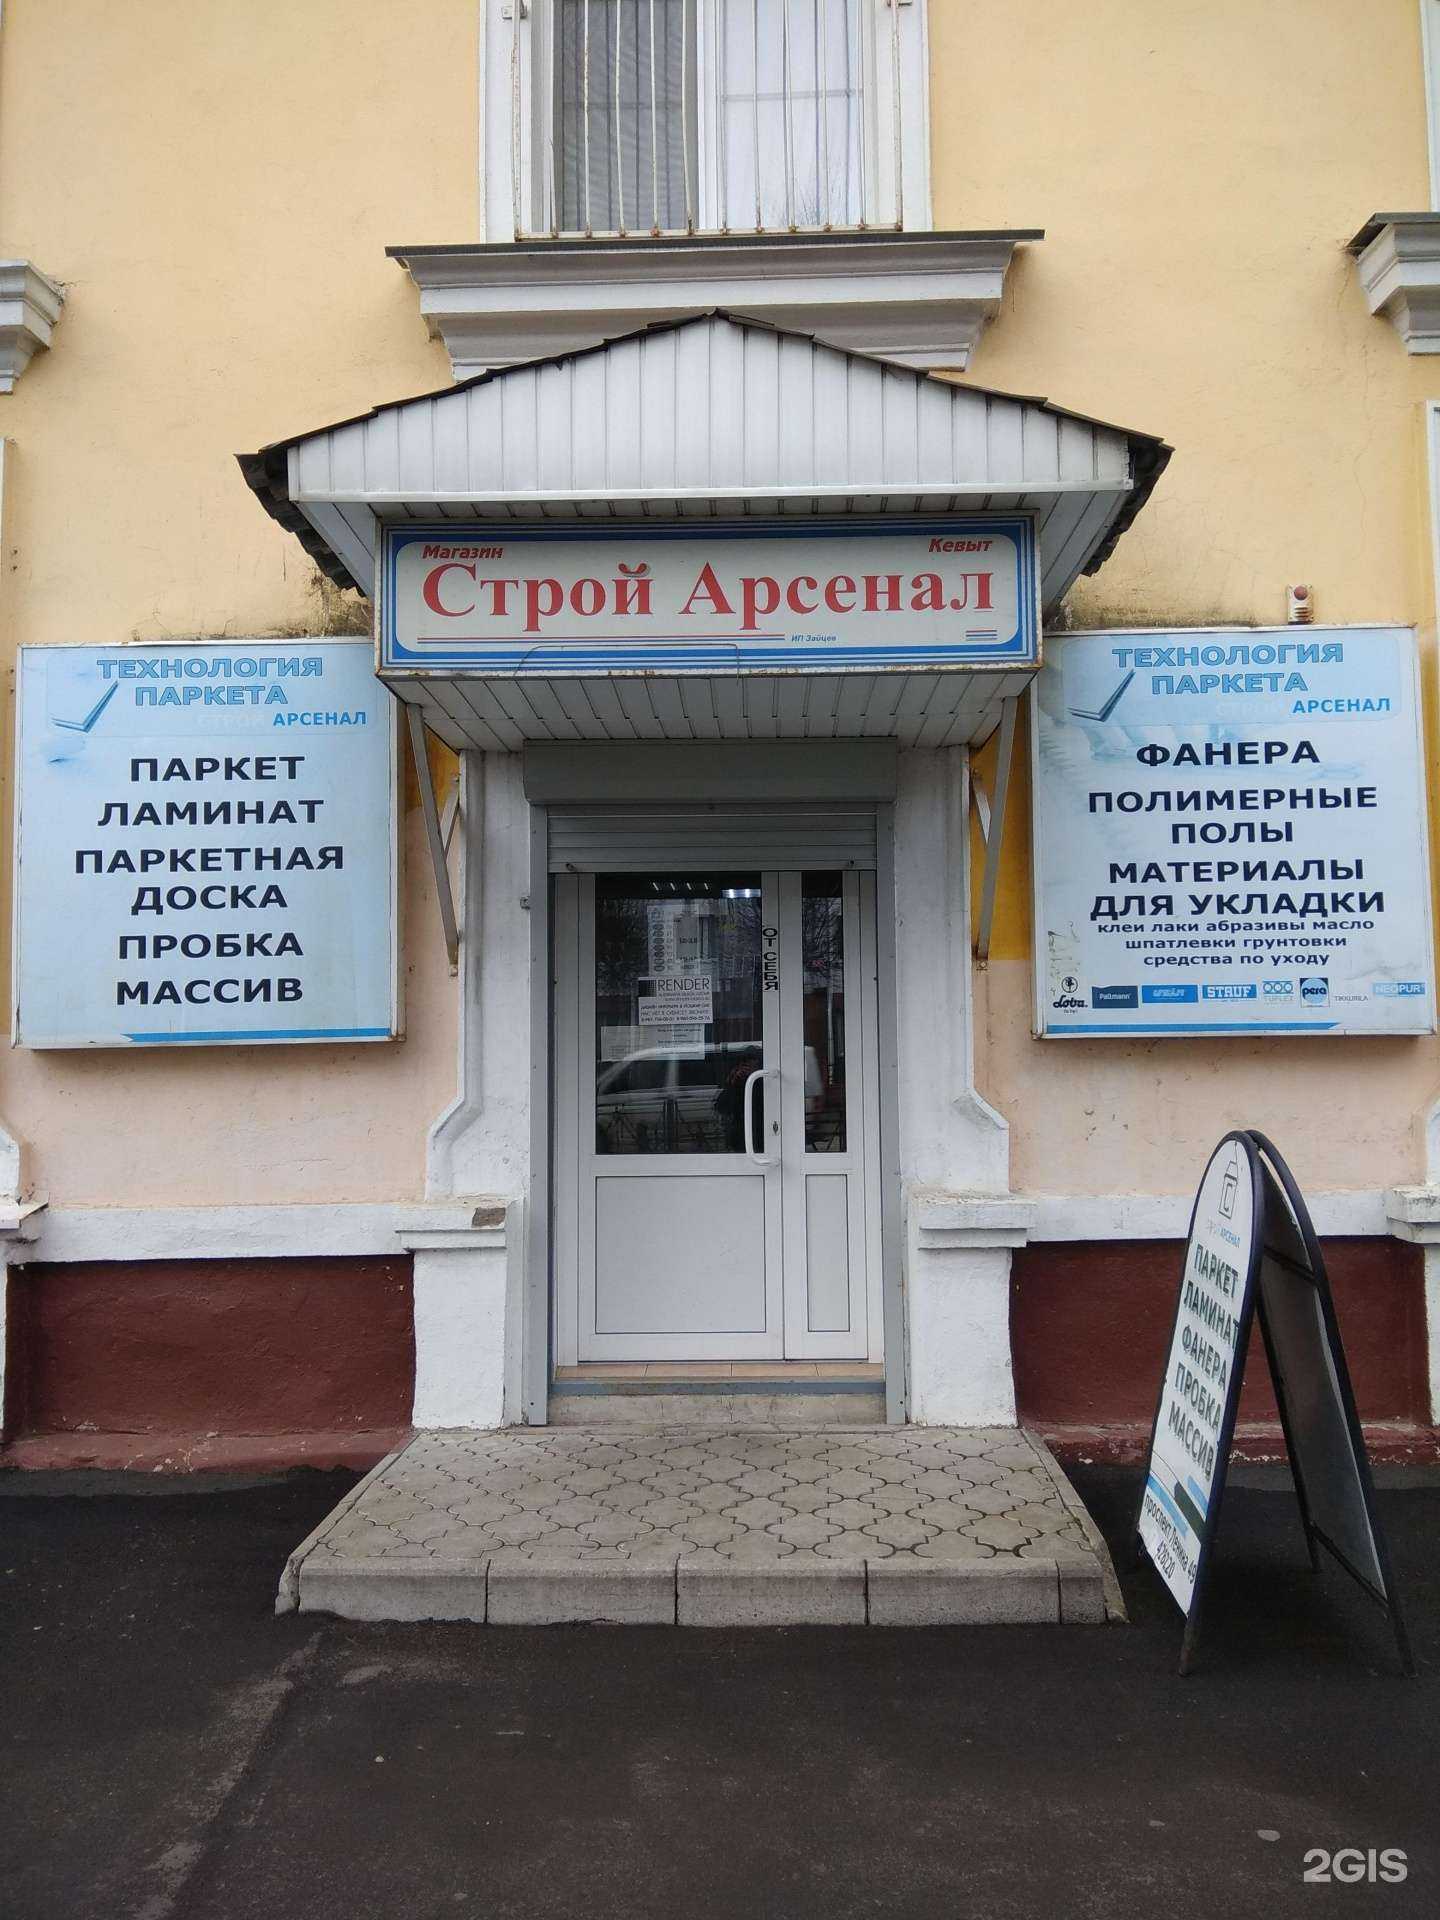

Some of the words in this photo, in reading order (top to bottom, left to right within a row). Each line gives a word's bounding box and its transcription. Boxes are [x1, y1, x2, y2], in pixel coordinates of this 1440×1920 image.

[422, 545, 503, 559] Магазин
[929, 537, 993, 553] Кевыт
[422, 562, 654, 632] Строй
[678, 561, 995, 630] Арсенал
[97, 657, 323, 679] ТЕХНОЛОГИЯ
[1112, 643, 1344, 668] ТЕХНОЛОГИЯ
[135, 685, 288, 706] ПАРКЕТА
[1152, 672, 1308, 695] ПАРКЕТА
[1292, 698, 1391, 714] АРСЕНАЛ
[273, 711, 367, 727] АРСЕНАЛ
[1136, 740, 1320, 767] ФАНЕРА
[131, 756, 305, 782] ПАРКЕТ
[1089, 786, 1378, 813] ПОЛИМЕРНЫЕ
[98, 800, 324, 826] ЛАМИНАТ
[1172, 821, 1293, 845] ПОЛЫ
[75, 846, 344, 873] ПАРКЕТНАЯ
[1109, 859, 1364, 884] МАТЕРИАЛЫ
[131, 884, 288, 915] ДОСКА
[1090, 896, 1174, 921] ДЛЯ
[1188, 891, 1385, 918] УКЛАДКИ
[763, 927, 778, 947] ОТ
[1098, 922, 1145, 933] клеи
[1151, 921, 1199, 932] лаки
[1206, 920, 1305, 933] абразивы
[1312, 919, 1374, 931] масло
[119, 932, 304, 959] ПРОБКА
[1125, 938, 1236, 950] шпатлевки
[1243, 936, 1347, 949] грунтовки
[763, 951, 779, 991] СЕБЯ
[1143, 954, 1233, 968] средства
[1240, 954, 1264, 965] по
[1271, 953, 1330, 967] уходу
[117, 978, 303, 1005] МАССИВ
[657, 977, 710, 991] RENDER
[1207, 986, 1251, 998] STAUF
[1194, 1243, 1239, 1299] ПАРКЕТ
[1184, 1280, 1239, 1349] ЛАМИНАТ
[1181, 1324, 1227, 1392] ФАНЕРА
[1175, 1361, 1221, 1434] ПРОБКА
[1168, 1400, 1214, 1482] МАССИВ
